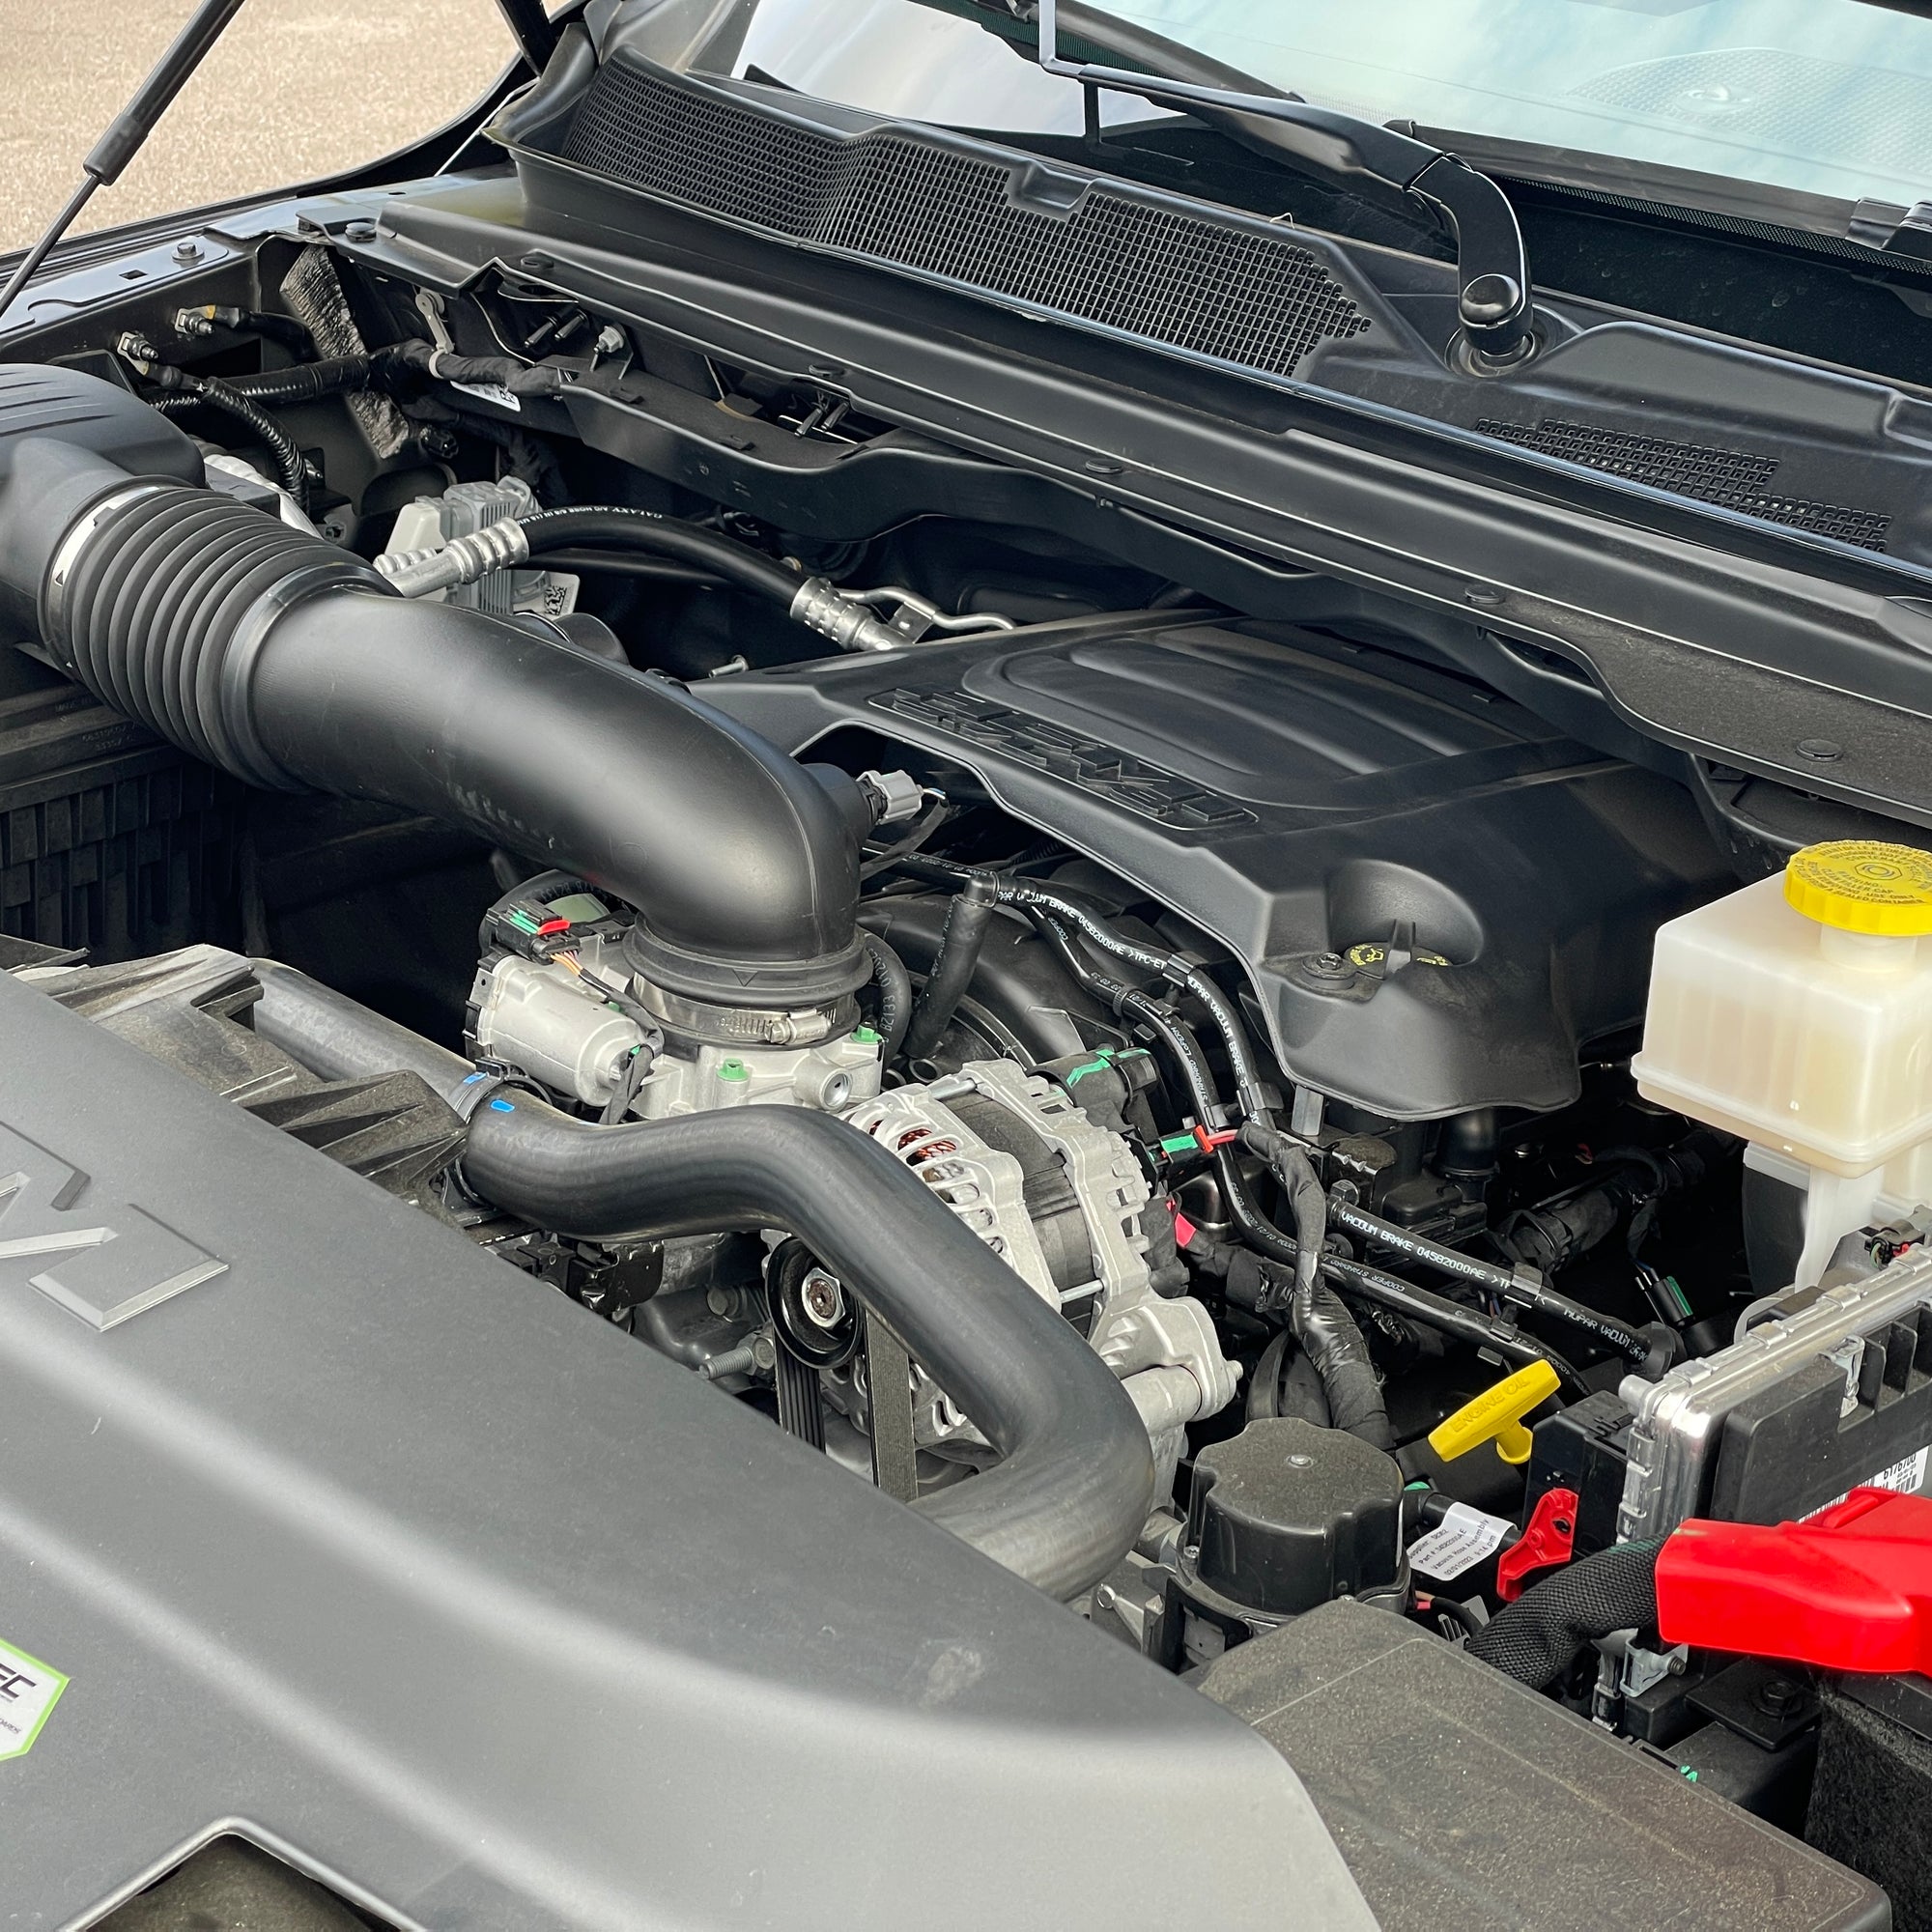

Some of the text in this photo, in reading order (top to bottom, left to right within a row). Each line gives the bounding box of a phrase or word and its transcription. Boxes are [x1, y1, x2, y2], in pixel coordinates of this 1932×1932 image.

[612, 506, 663, 519] GALAXY
[1048, 895, 1078, 919] BRAKE
[1228, 1040, 1246, 1076] BRAKE
[1379, 1230, 1415, 1252] BRAKE
[1416, 1246, 1488, 1280] 04582000AE
[1371, 1274, 1406, 1293] COOPER
[1450, 1377, 1531, 1433] ENGINE OIL
[1464, 1519, 1490, 1548] Assembly
